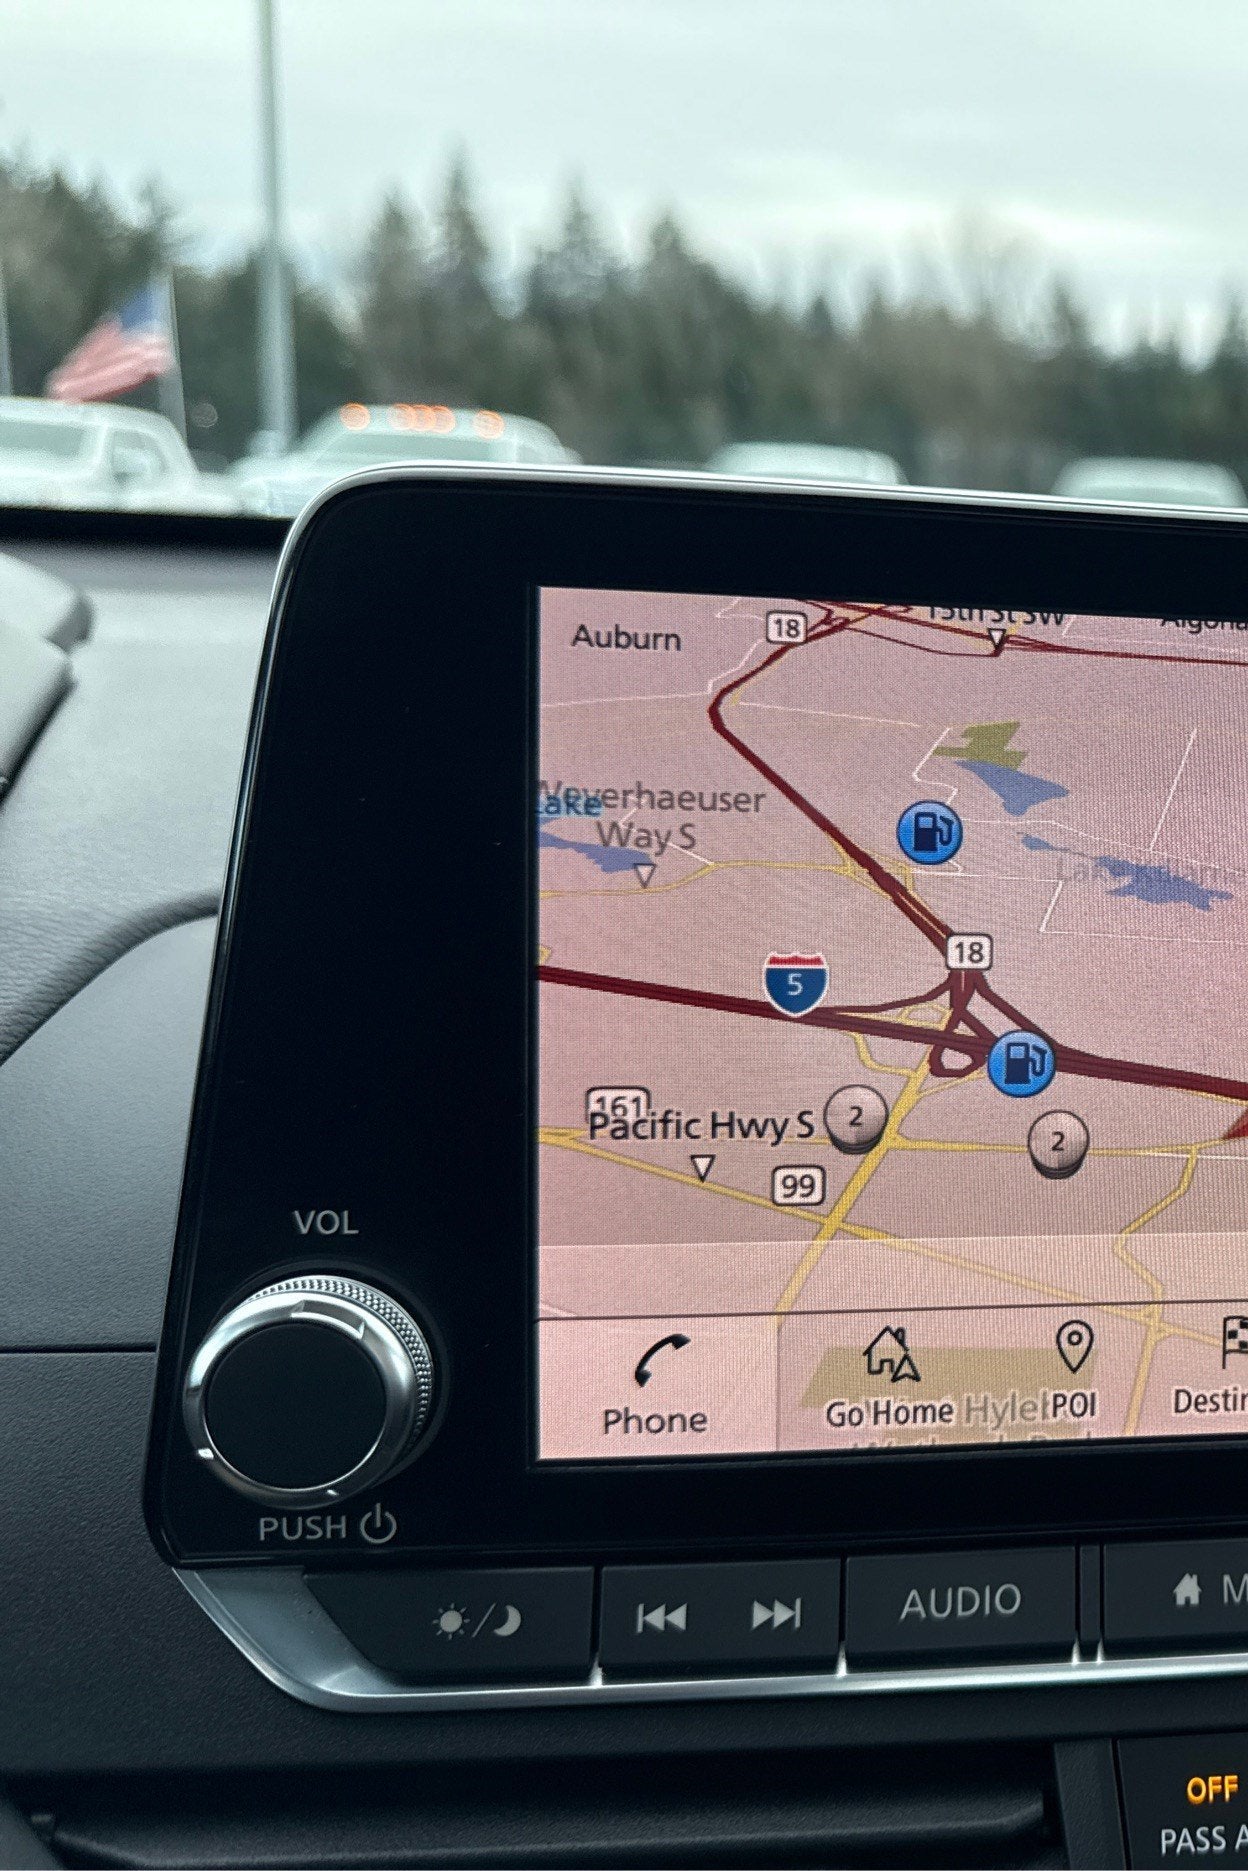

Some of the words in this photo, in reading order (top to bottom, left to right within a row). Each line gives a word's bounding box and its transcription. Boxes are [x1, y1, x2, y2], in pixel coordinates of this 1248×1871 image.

[571, 623, 681, 650] Auburn
[774, 618, 801, 638] 18
[539, 788, 602, 817] ake
[597, 821, 671, 856] Way
[679, 822, 697, 850] S
[954, 942, 985, 964] 18
[787, 973, 802, 996] 5
[596, 1096, 642, 1117] 161
[849, 1106, 863, 1126] 2
[589, 1109, 700, 1140] Pacific
[711, 1111, 789, 1147] Hwy
[797, 1110, 815, 1139] S
[1051, 1131, 1065, 1152] 2
[781, 1174, 816, 1198] 99
[293, 1210, 359, 1235] VOL
[826, 1400, 863, 1427] Go
[873, 1399, 953, 1426] Home
[1052, 1392, 1097, 1418] POI
[603, 1406, 708, 1435] Phone
[259, 1515, 347, 1541] PUSH
[900, 1583, 1021, 1621] AUDIO
[1186, 1775, 1239, 1804] OFF
[1161, 1825, 1227, 1855] PASS
